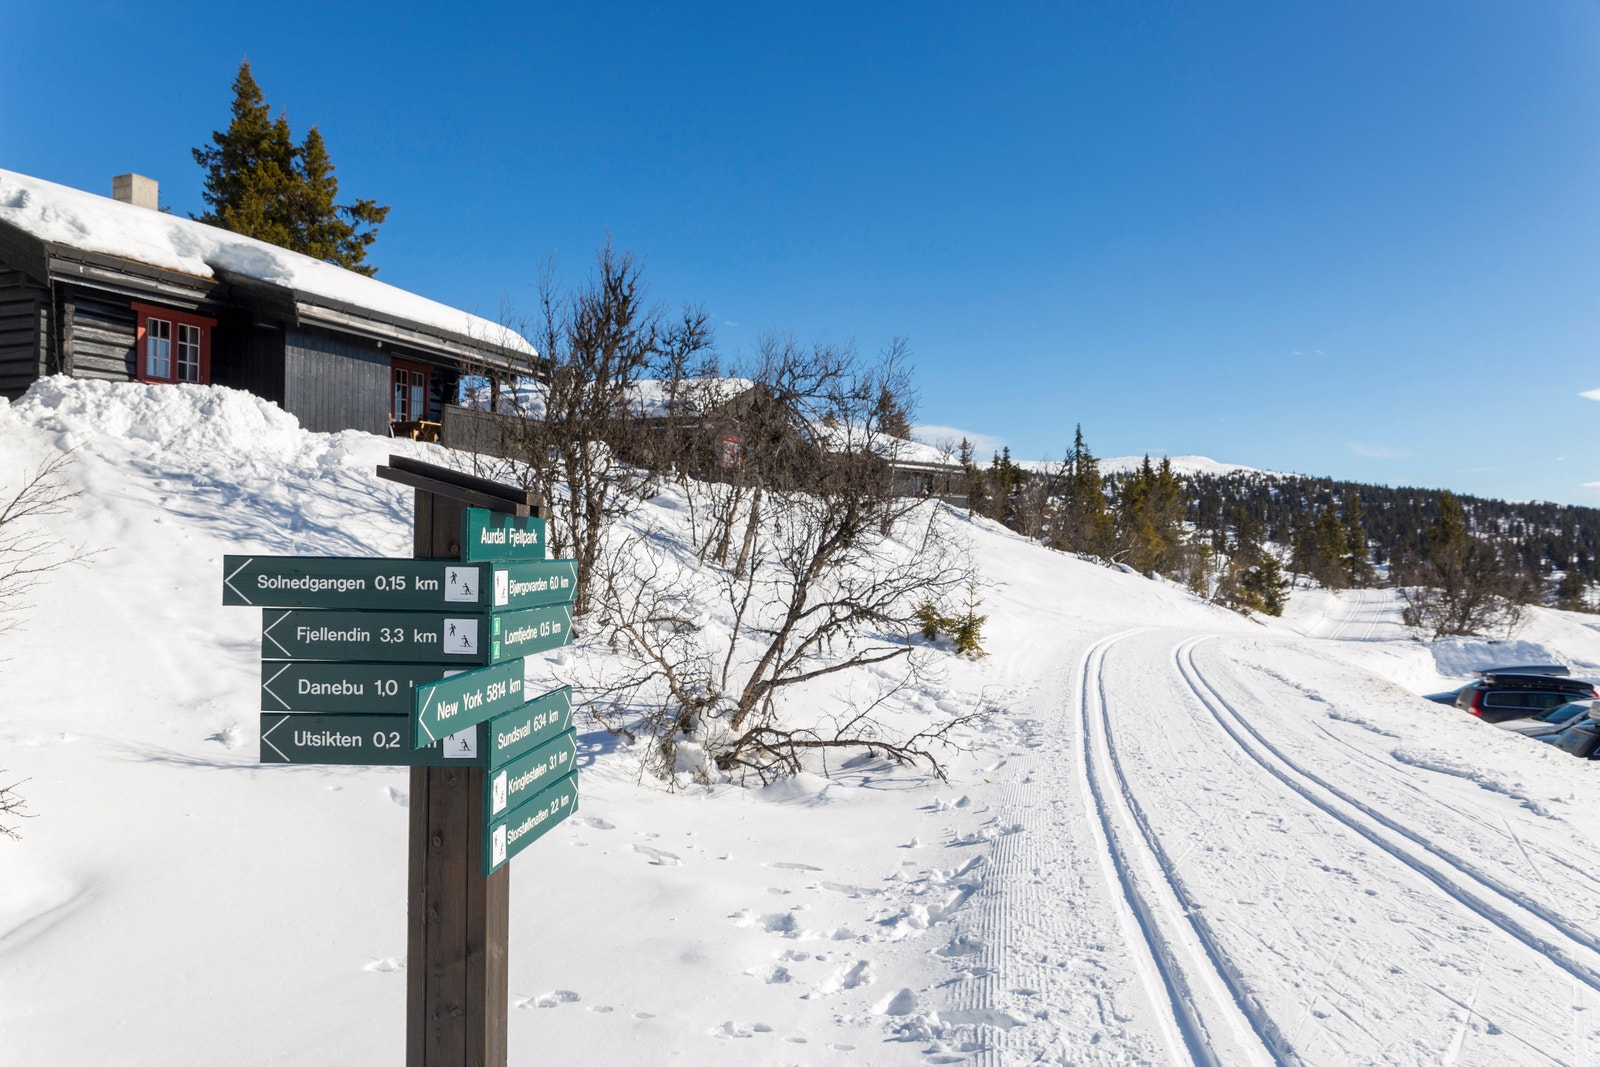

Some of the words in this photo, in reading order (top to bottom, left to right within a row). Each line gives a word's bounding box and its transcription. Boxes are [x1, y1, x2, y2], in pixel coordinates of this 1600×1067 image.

[481, 527, 506, 544] Aurdal
[509, 527, 538, 548] Fjellpark
[257, 575, 365, 592] Solnedgangen
[374, 575, 406, 592] 0,15
[415, 576, 438, 591] km
[509, 577, 548, 597] Bjørgovarden
[550, 576, 559, 591] 6,0
[560, 575, 569, 589] km
[297, 627, 370, 643] Fjellendin
[379, 628, 404, 644] 3,3
[414, 629, 437, 643] km
[504, 626, 538, 645] Lomtjedne
[540, 622, 550, 638] 0,5
[552, 621, 561, 634] km
[298, 679, 364, 695] Danebu
[374, 680, 398, 697] 1,0
[437, 701, 458, 721] New
[463, 691, 483, 712] York
[486, 682, 506, 702] 5814
[509, 679, 521, 695] km
[294, 731, 362, 747] Utsikten
[373, 732, 400, 749] 0,2
[498, 720, 531, 750] Sundsvall
[533, 712, 547, 732] 634
[549, 710, 559, 724] km
[508, 763, 547, 796] Kringlestølen
[549, 755, 557, 770] 3,1
[559, 751, 568, 763] km
[551, 798, 559, 815] 2,2
[560, 795, 569, 807] km
